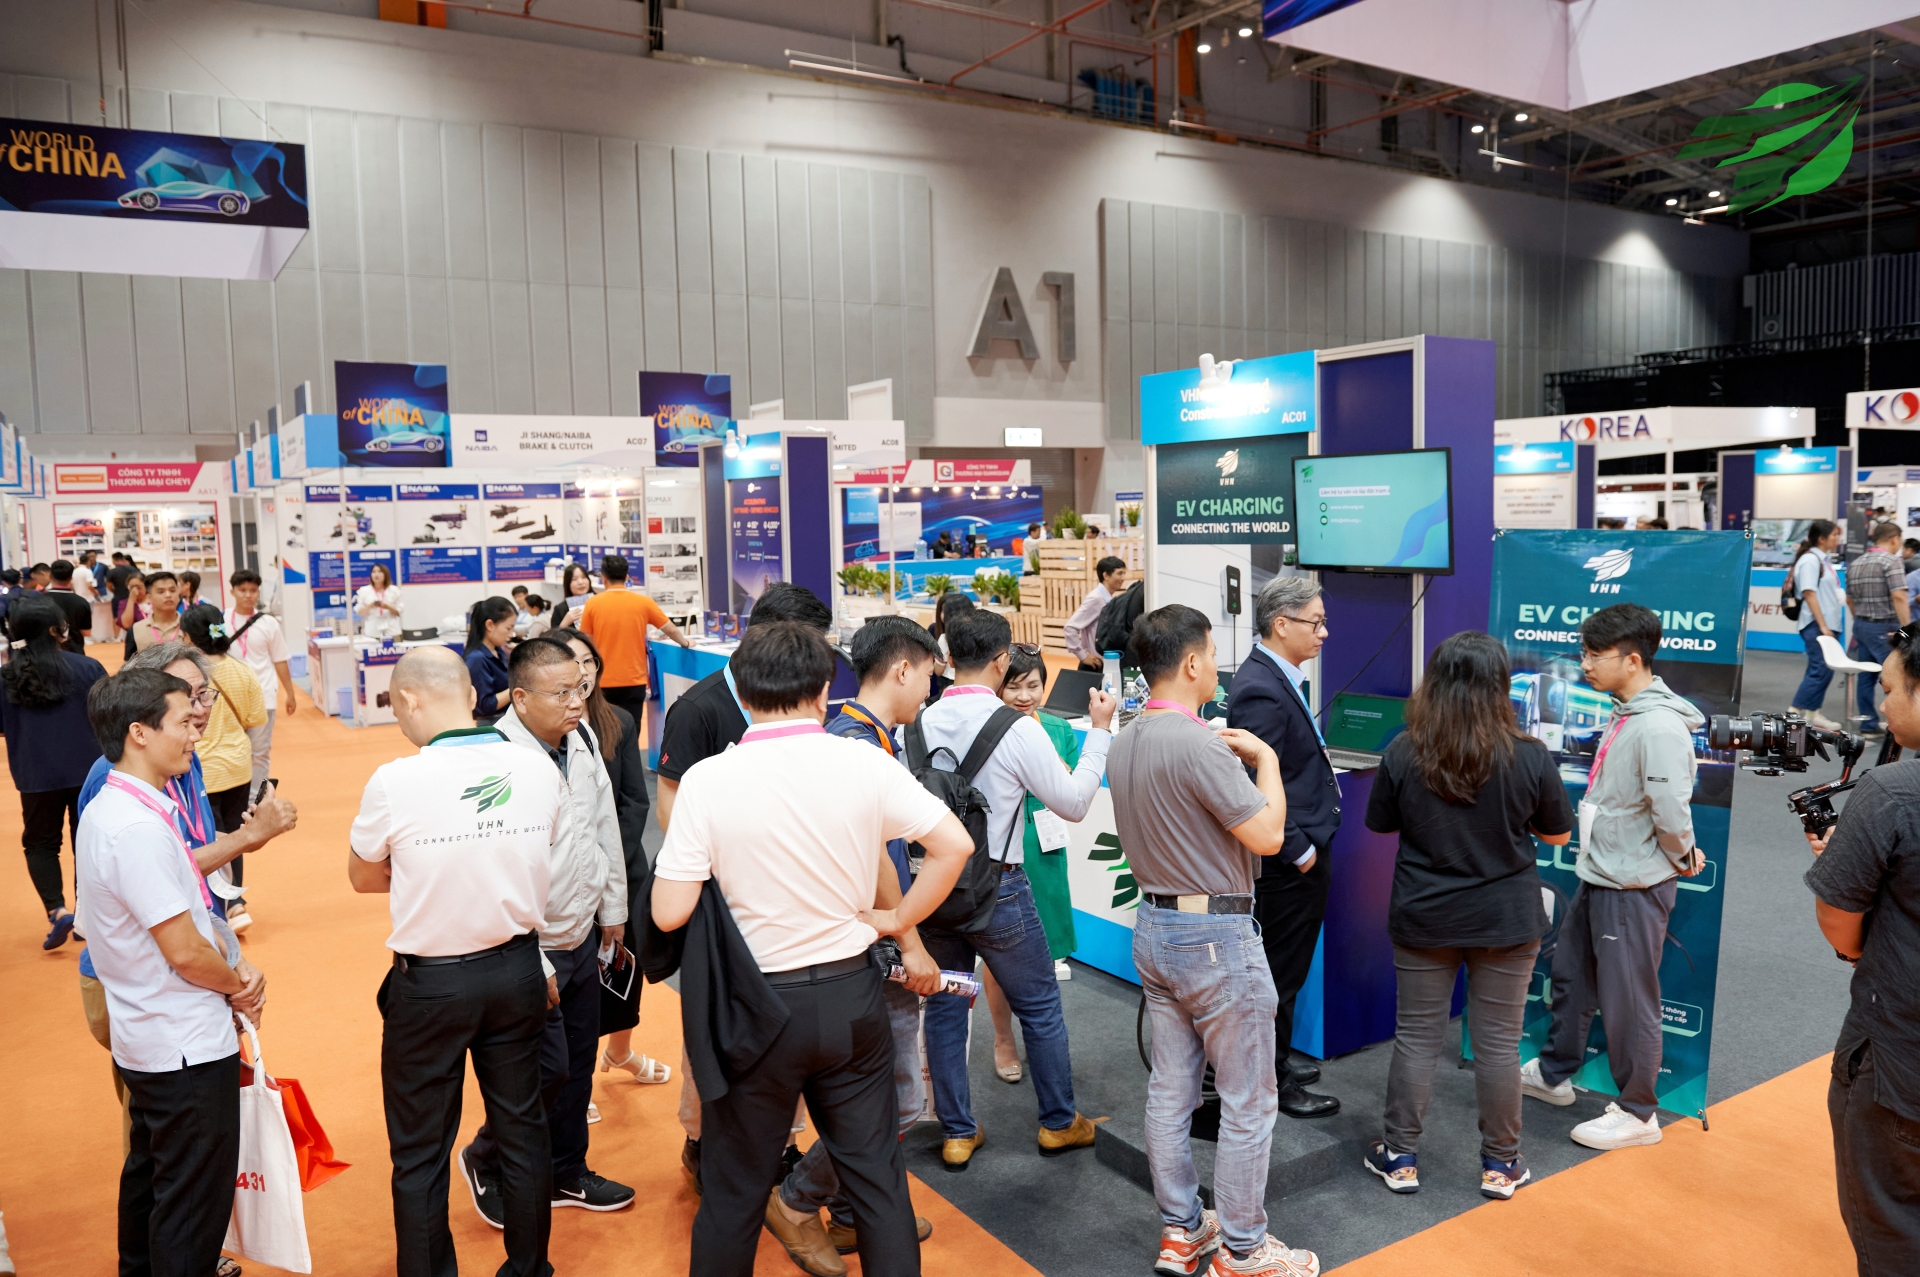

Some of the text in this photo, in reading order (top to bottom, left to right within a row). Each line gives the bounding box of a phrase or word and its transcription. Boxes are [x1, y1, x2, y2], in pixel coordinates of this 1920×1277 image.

[10, 128, 95, 153] WORLD
[8, 144, 126, 179] CHINA
[966, 266, 1076, 362] A1
[342, 407, 424, 426] of CHINA
[657, 412, 712, 429] CHINA
[1281, 411, 1307, 423] AC01
[1559, 414, 1651, 441] KOREA
[520, 431, 591, 440] JI SHANG/NAIBA
[118, 468, 181, 477] CÔNG TY TNHH
[165, 478, 191, 486] CHEYI
[1220, 477, 1235, 486] VHN
[409, 485, 440, 493] NAIBA
[493, 484, 524, 492] NAIBA
[1177, 496, 1284, 517] EV CHARGING
[1171, 521, 1291, 534] CONNECTING THE WORLD
[1590, 583, 1621, 594] VHN
[1518, 604, 1555, 624] EV
[477, 819, 504, 831] VHN
[415, 831, 491, 846] CONNECTING
[498, 828, 517, 836] THE
[1665, 1006, 1687, 1017] thông
[1674, 1014, 1688, 1024] cấp
